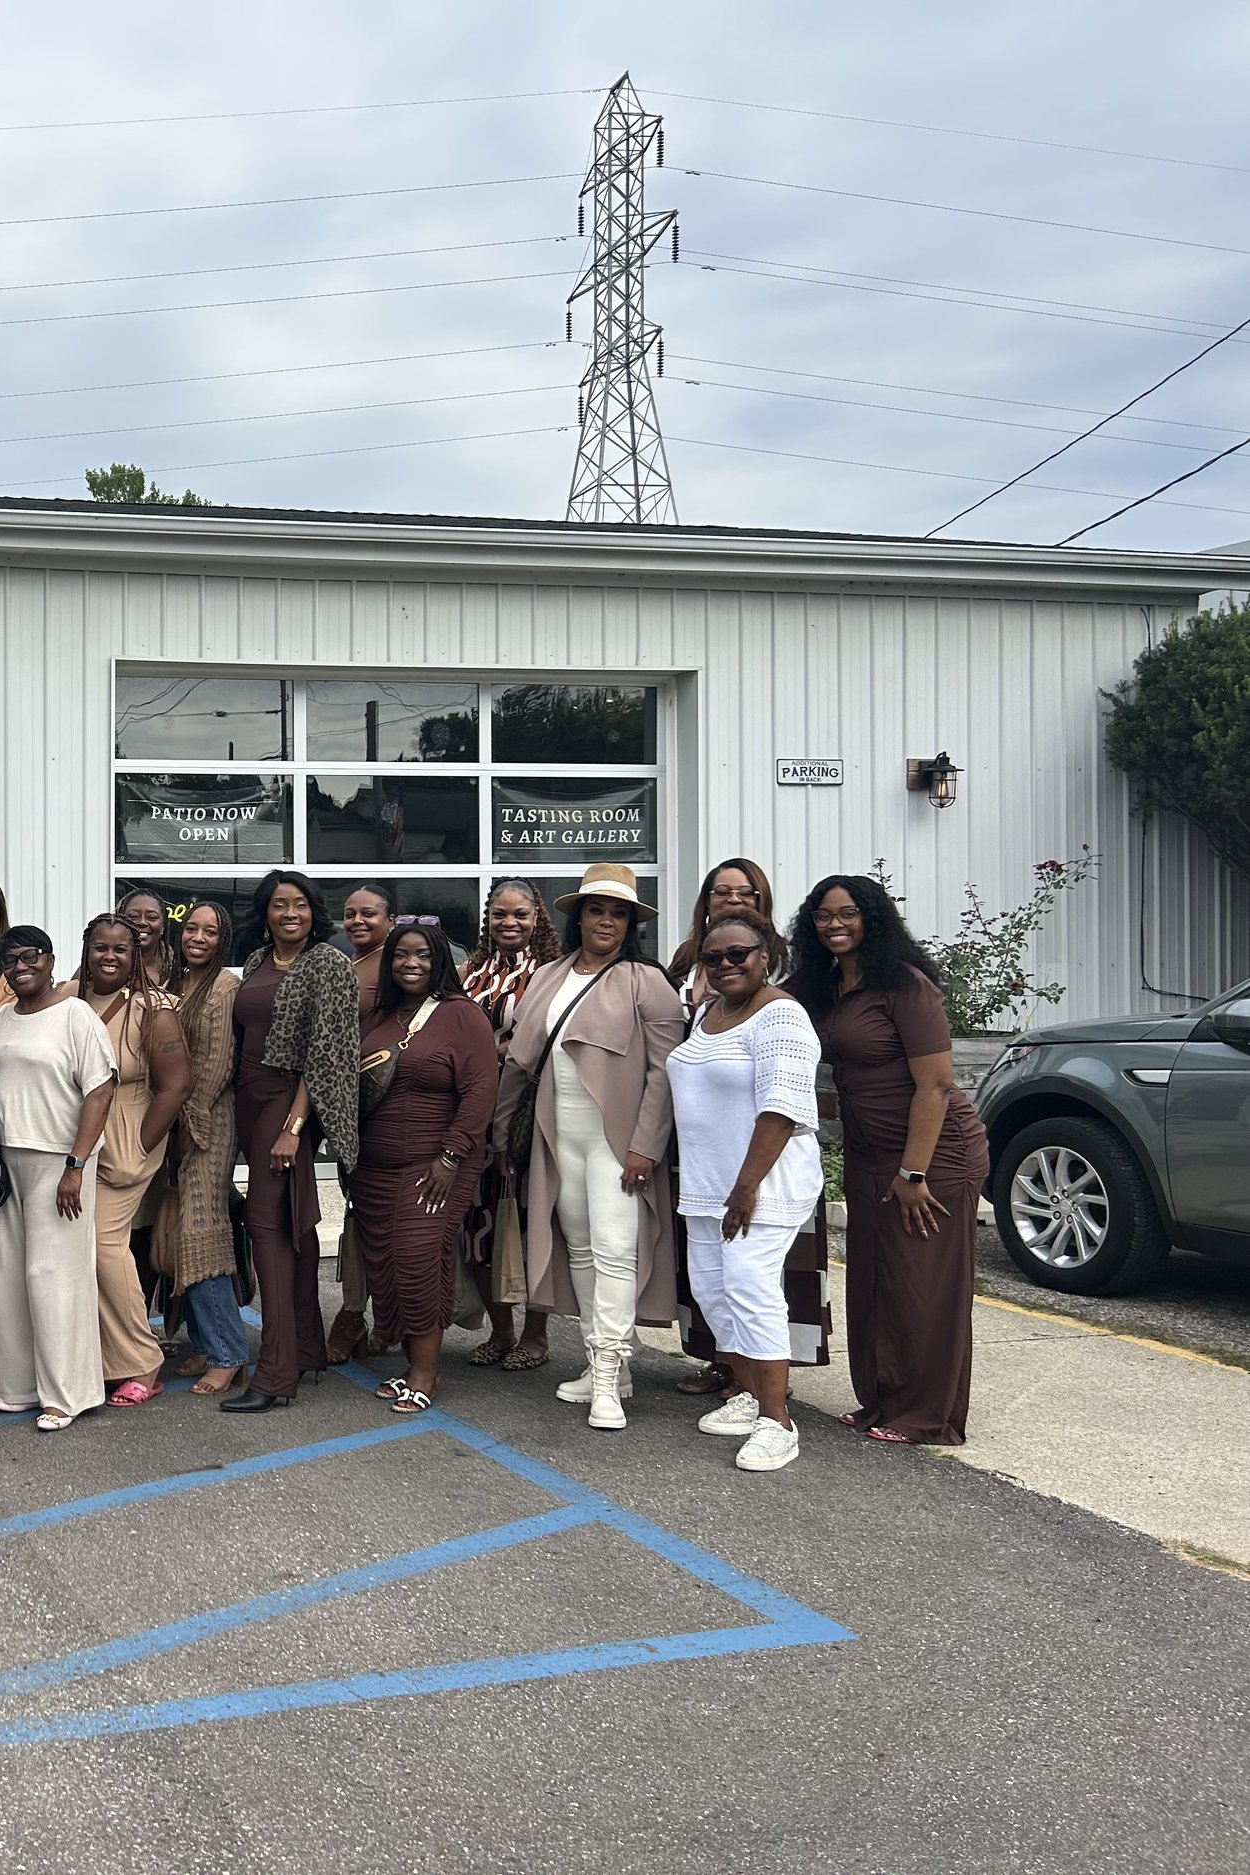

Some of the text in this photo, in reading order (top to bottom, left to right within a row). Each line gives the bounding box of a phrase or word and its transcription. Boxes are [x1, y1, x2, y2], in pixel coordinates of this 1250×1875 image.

[782, 766, 839, 778] PARKING
[151, 806, 257, 821] PATIO NOW
[502, 808, 641, 823] TASTING ROOM
[179, 828, 230, 841] OPEN
[501, 829, 642, 844] & ART GALLERY
